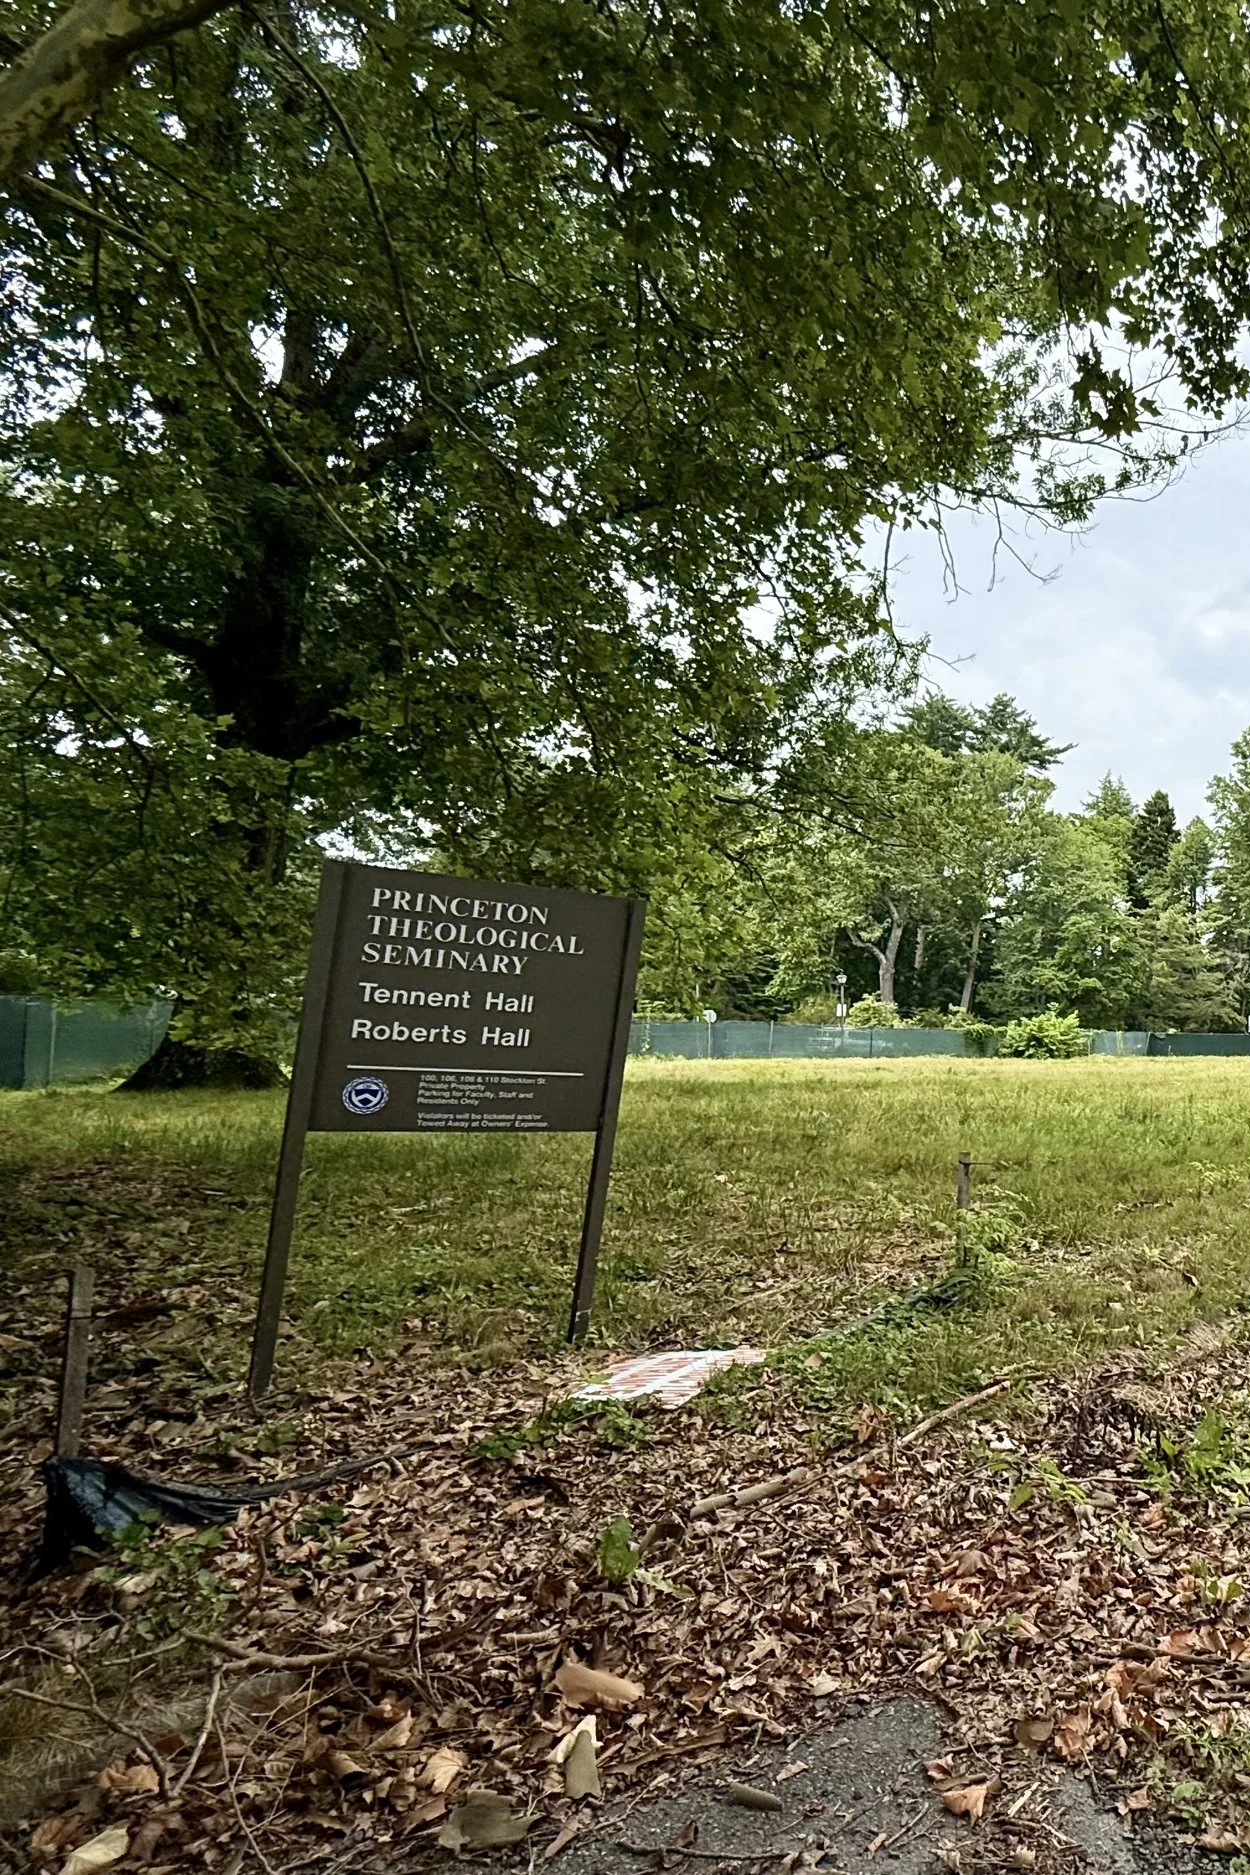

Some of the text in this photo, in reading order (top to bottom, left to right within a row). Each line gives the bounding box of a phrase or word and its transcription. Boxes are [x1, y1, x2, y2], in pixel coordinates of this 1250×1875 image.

[371, 888, 549, 925] PRINCETON
[367, 914, 585, 955] THEOLOGICAL
[361, 943, 528, 975] SEMINARY
[359, 982, 534, 1013] Tennent Hall
[351, 1019, 530, 1047] Roberts Hall
[418, 1089, 450, 1098] Parking
[465, 1091, 497, 1099] Faculty,
[419, 1082, 485, 1091] Private Property
[460, 1098, 480, 1106] Only
[417, 1119, 445, 1127] Towed
[447, 1120, 469, 1128] Away
